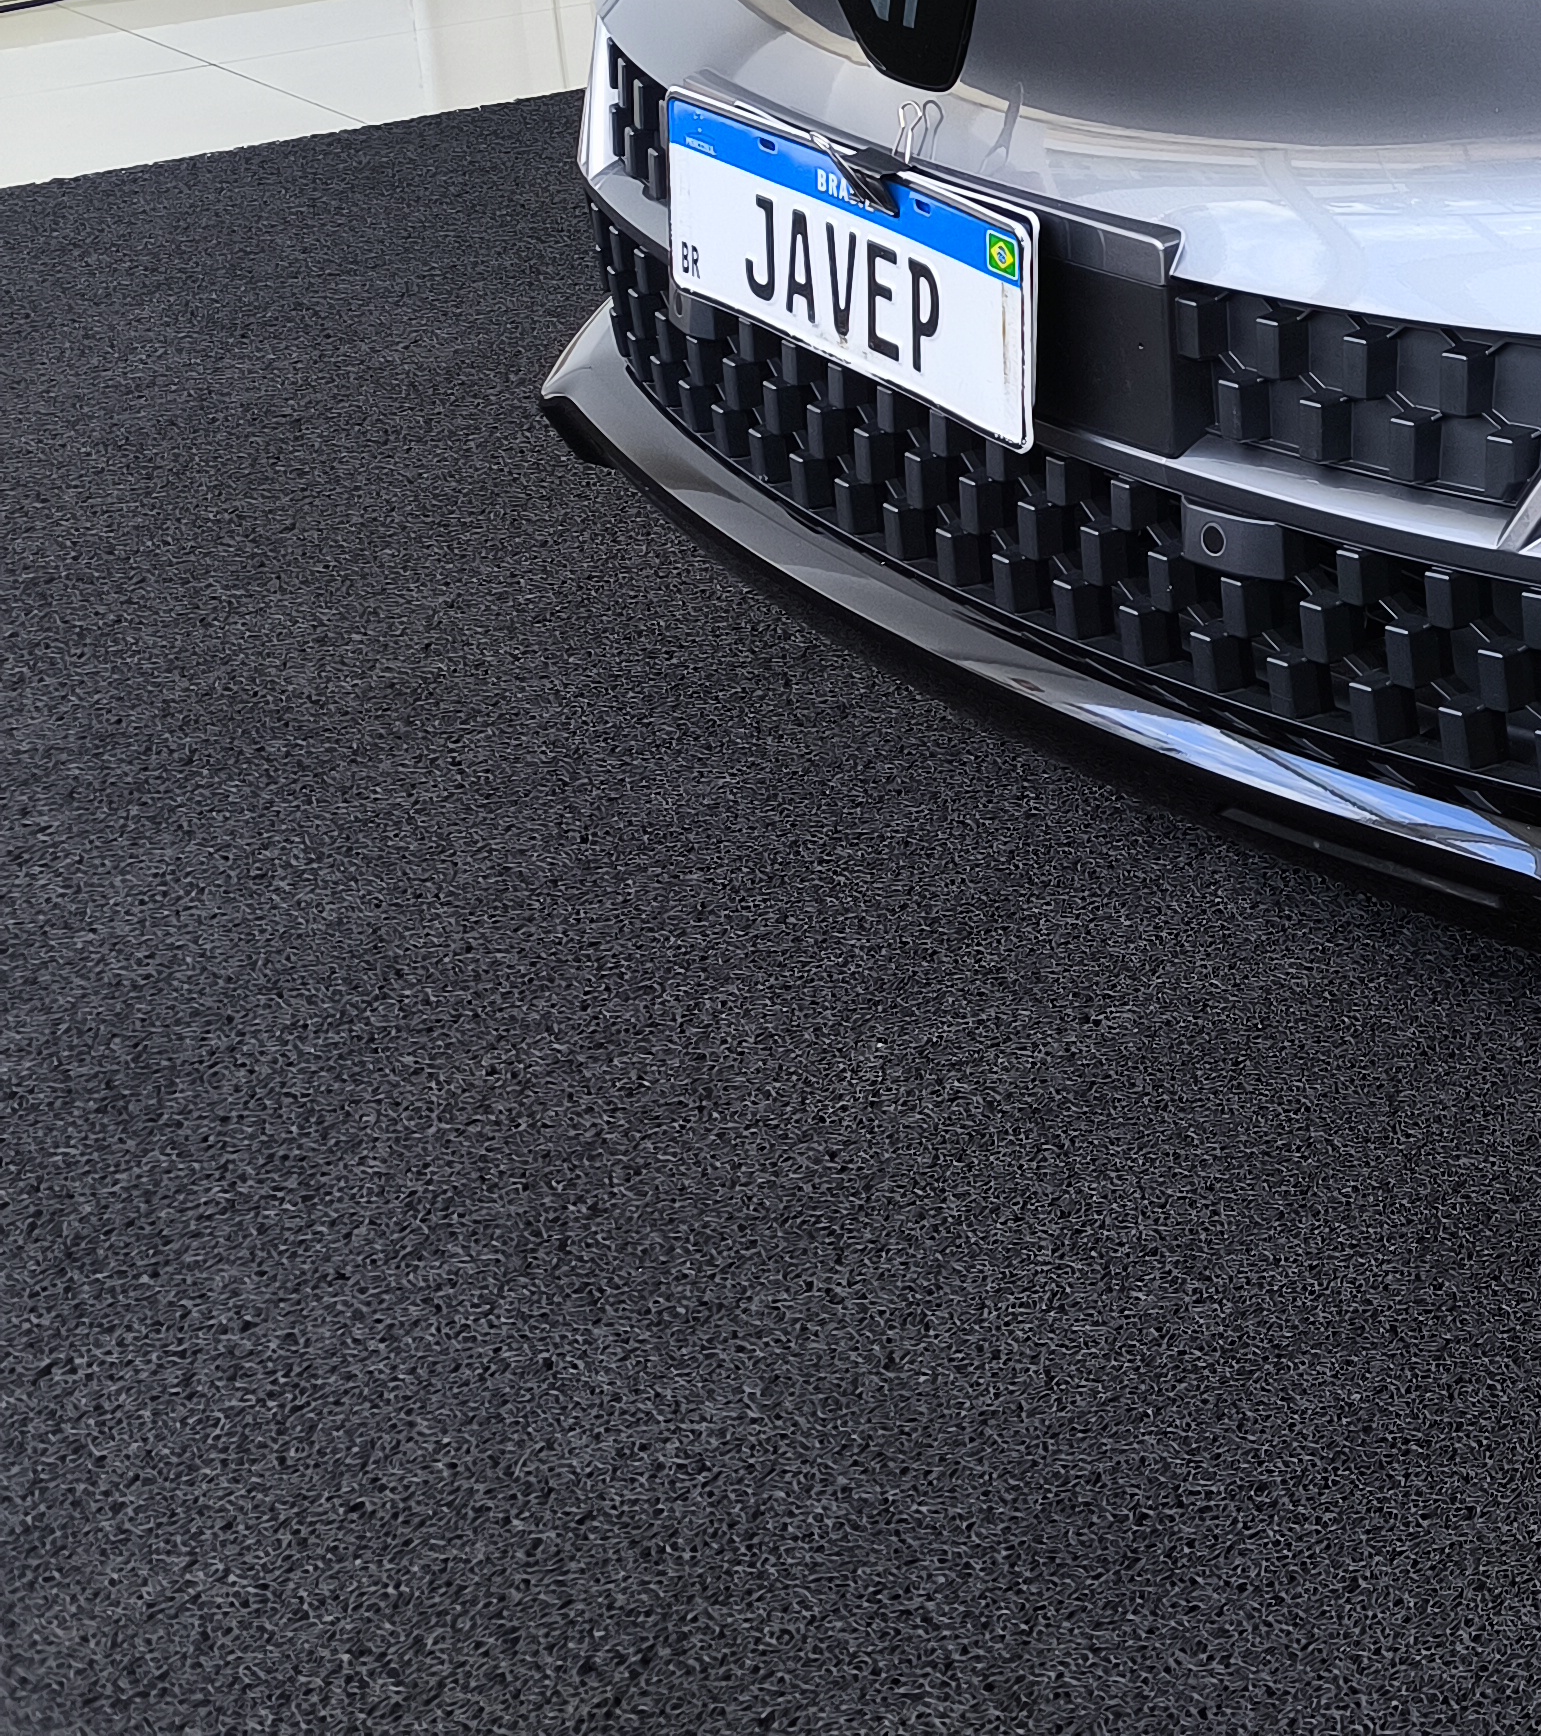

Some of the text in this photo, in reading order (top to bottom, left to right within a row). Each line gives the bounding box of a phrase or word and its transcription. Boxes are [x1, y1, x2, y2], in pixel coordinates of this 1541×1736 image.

[817, 168, 875, 212] BRAL
[682, 240, 700, 279] BR
[745, 194, 939, 373] JAVEP
